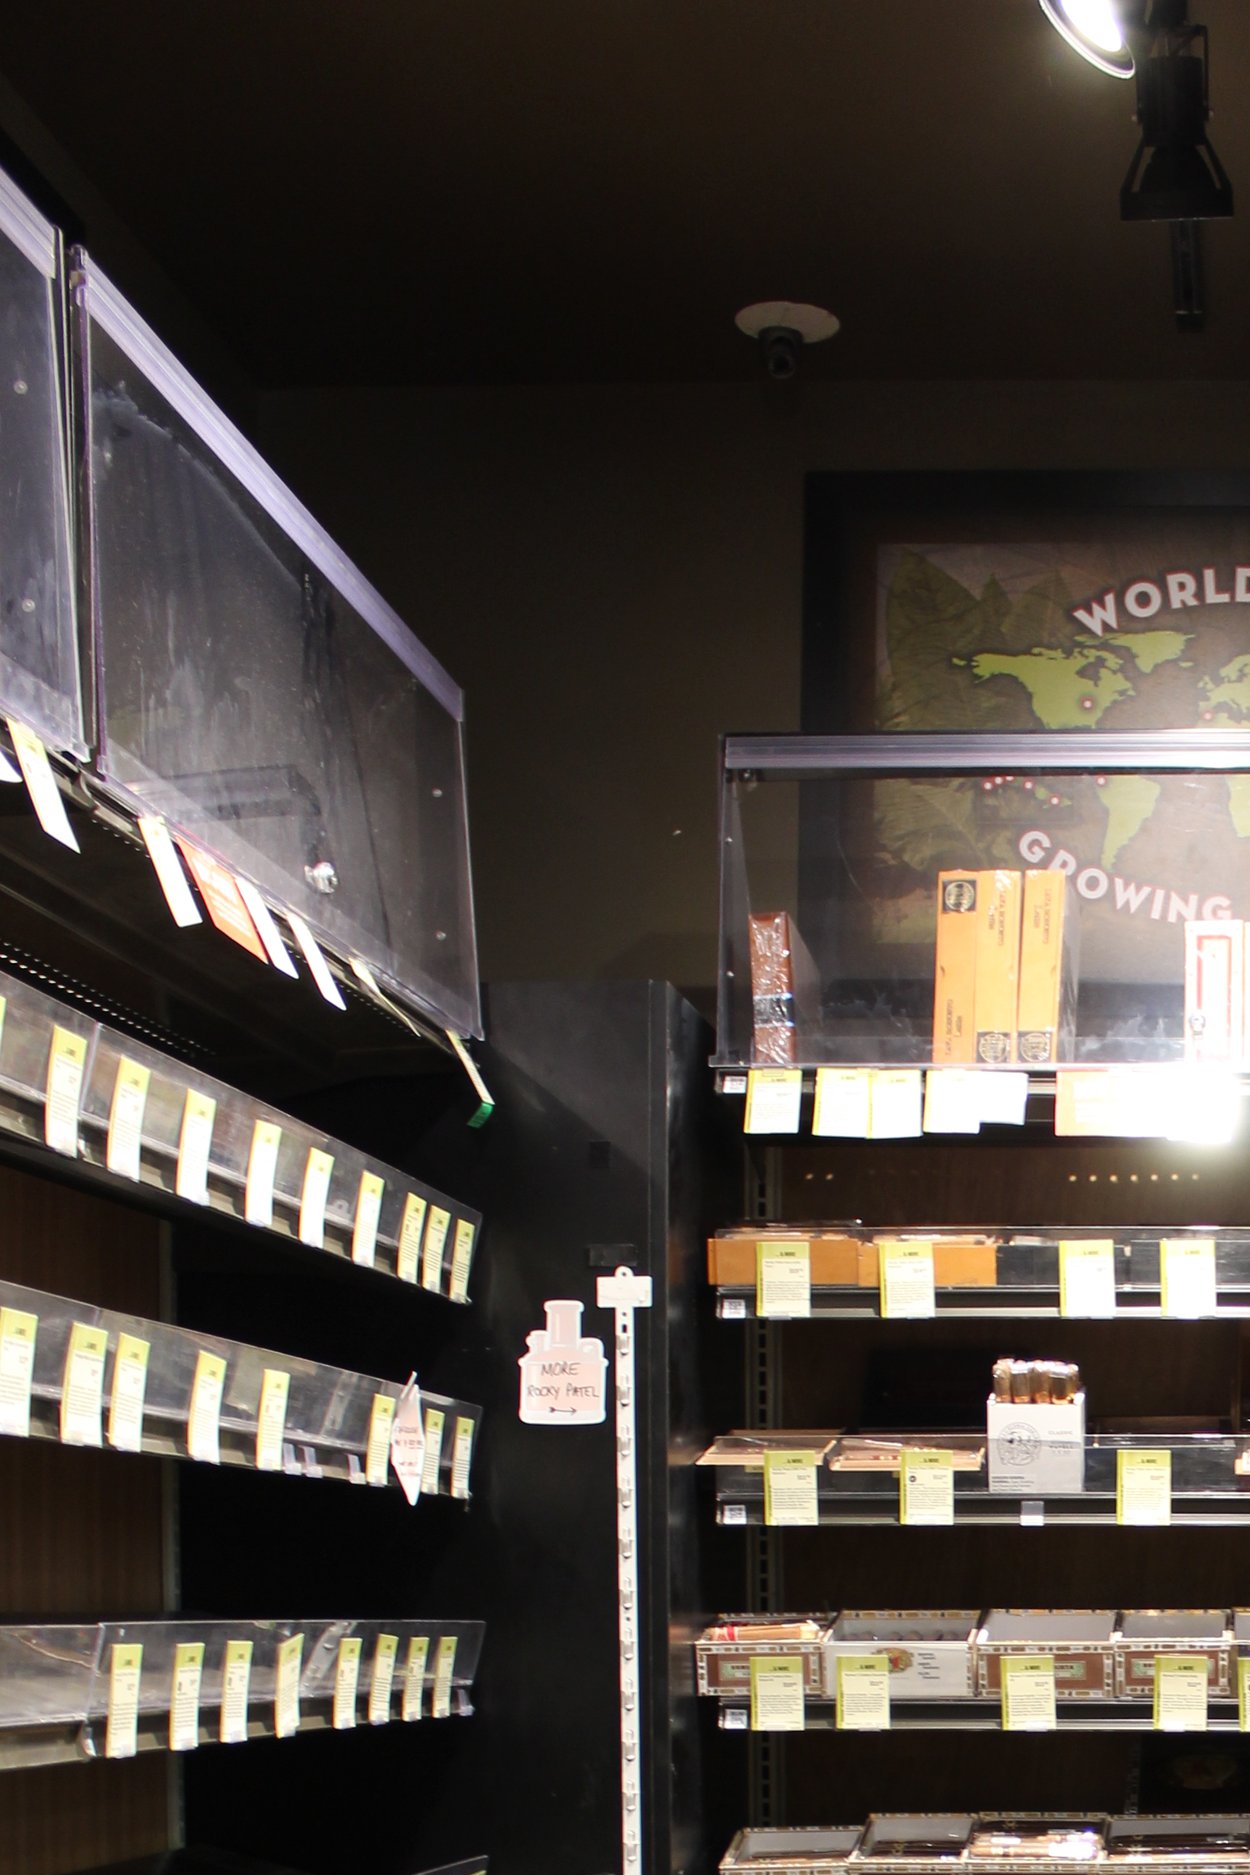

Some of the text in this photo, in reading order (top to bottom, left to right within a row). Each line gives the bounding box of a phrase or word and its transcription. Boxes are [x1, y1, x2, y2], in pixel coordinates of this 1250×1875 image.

[1019, 830, 1233, 924] GROWING
[540, 1361, 582, 1376] MORE
[527, 1382, 600, 1400] ROCKY PATEL
